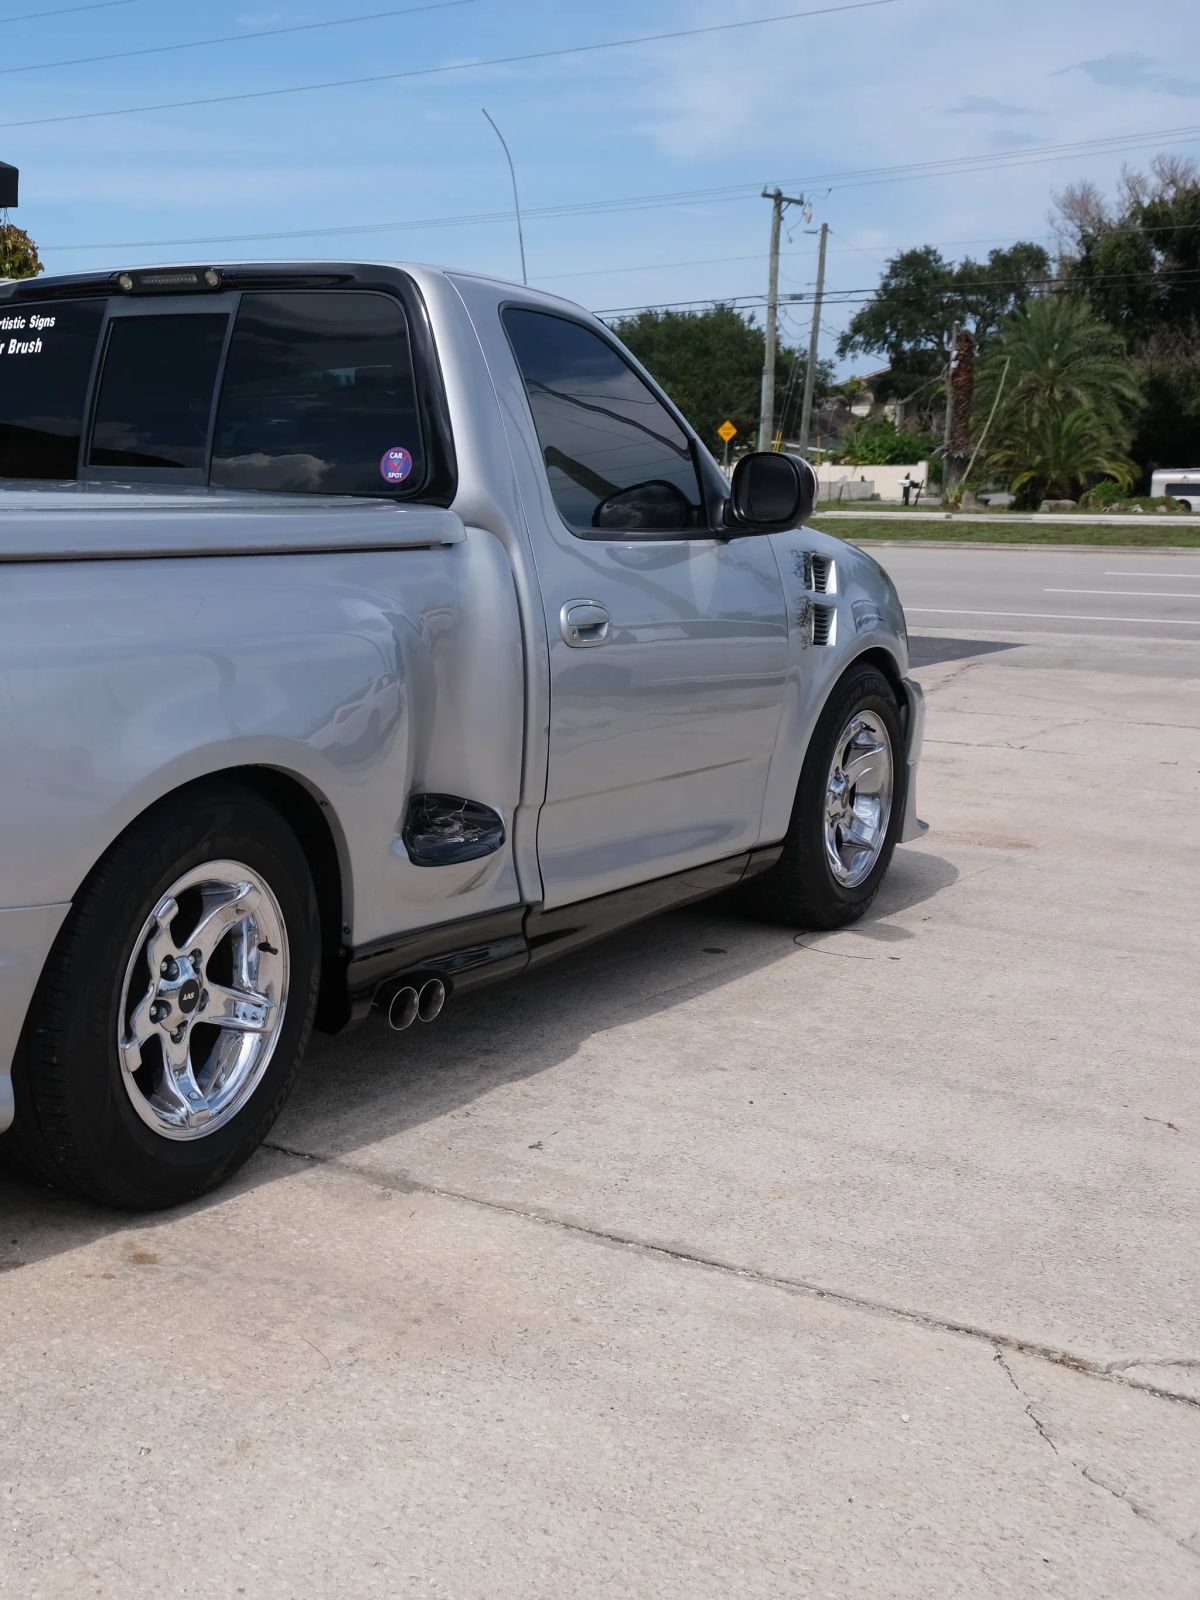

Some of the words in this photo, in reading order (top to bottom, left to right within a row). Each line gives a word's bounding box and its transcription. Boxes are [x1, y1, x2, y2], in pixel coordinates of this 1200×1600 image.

[29, 314, 56, 331] Signs
[8, 337, 43, 355] Brush
[387, 471, 403, 479] SPOT
